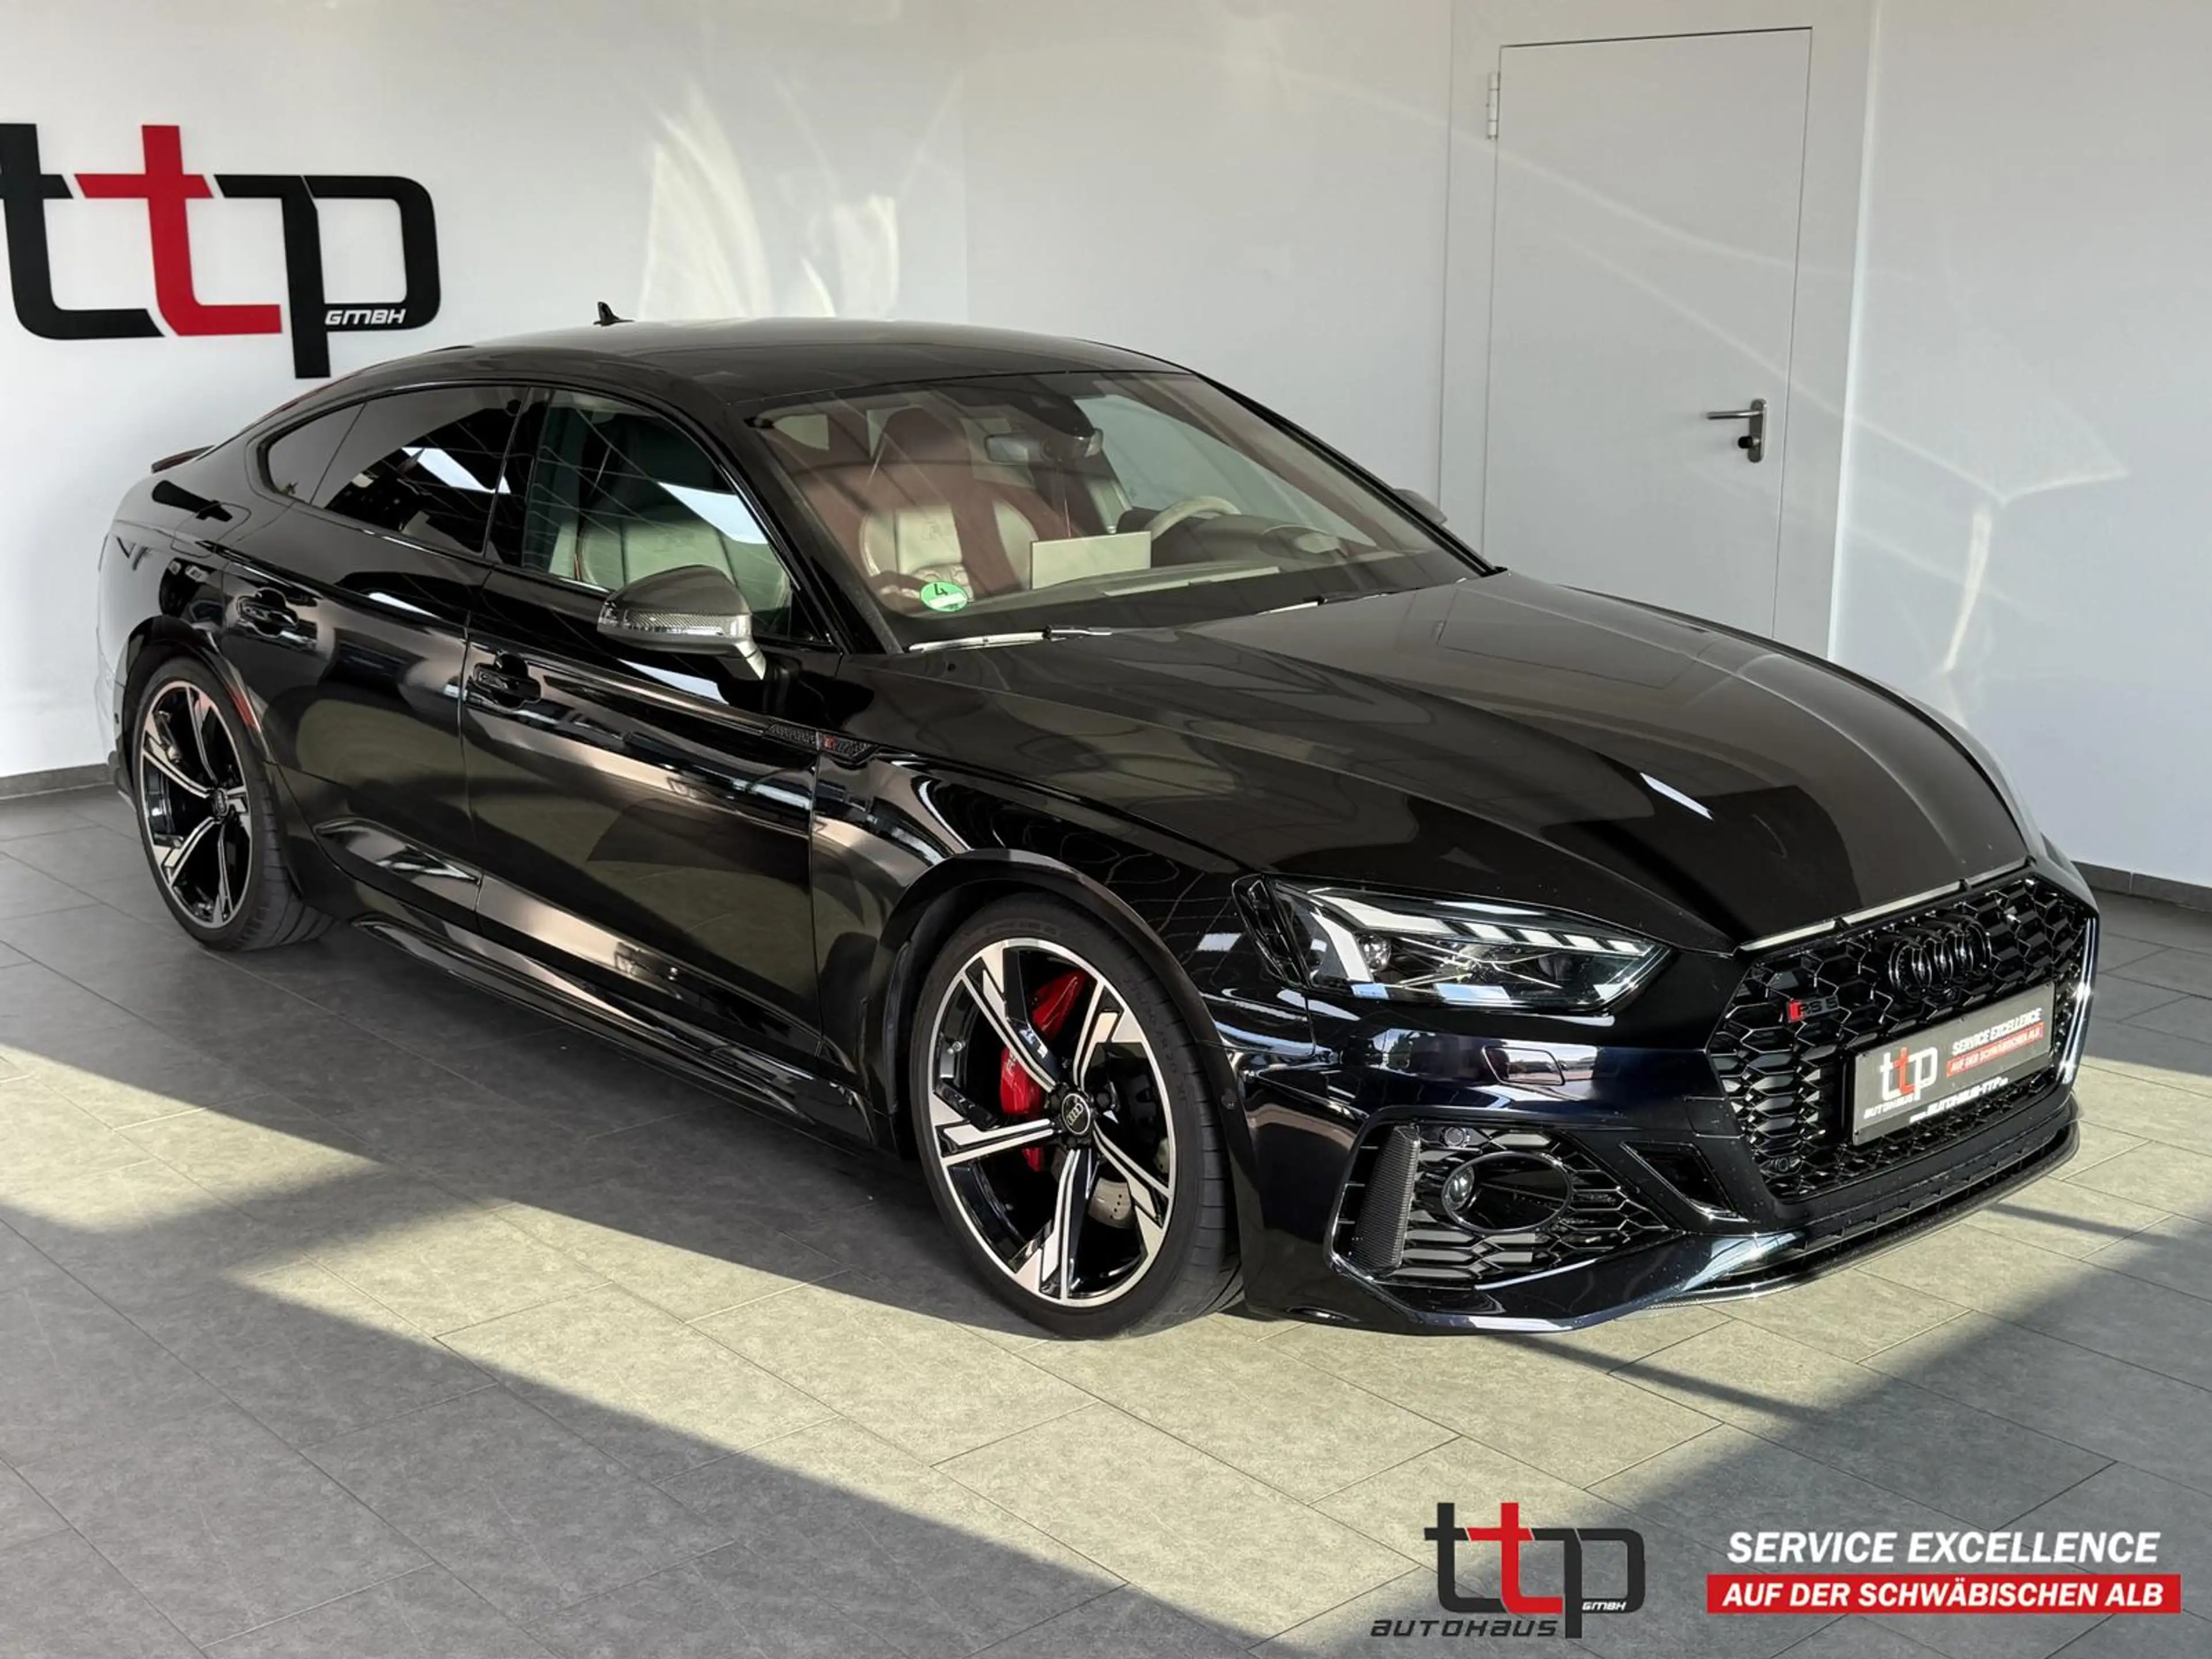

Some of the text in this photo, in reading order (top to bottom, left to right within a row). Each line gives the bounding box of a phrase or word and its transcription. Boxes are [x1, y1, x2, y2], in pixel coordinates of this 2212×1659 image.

[0, 123, 440, 378] ttp
[933, 583, 949, 596] 4
[1880, 1046, 1938, 1101] ttp
